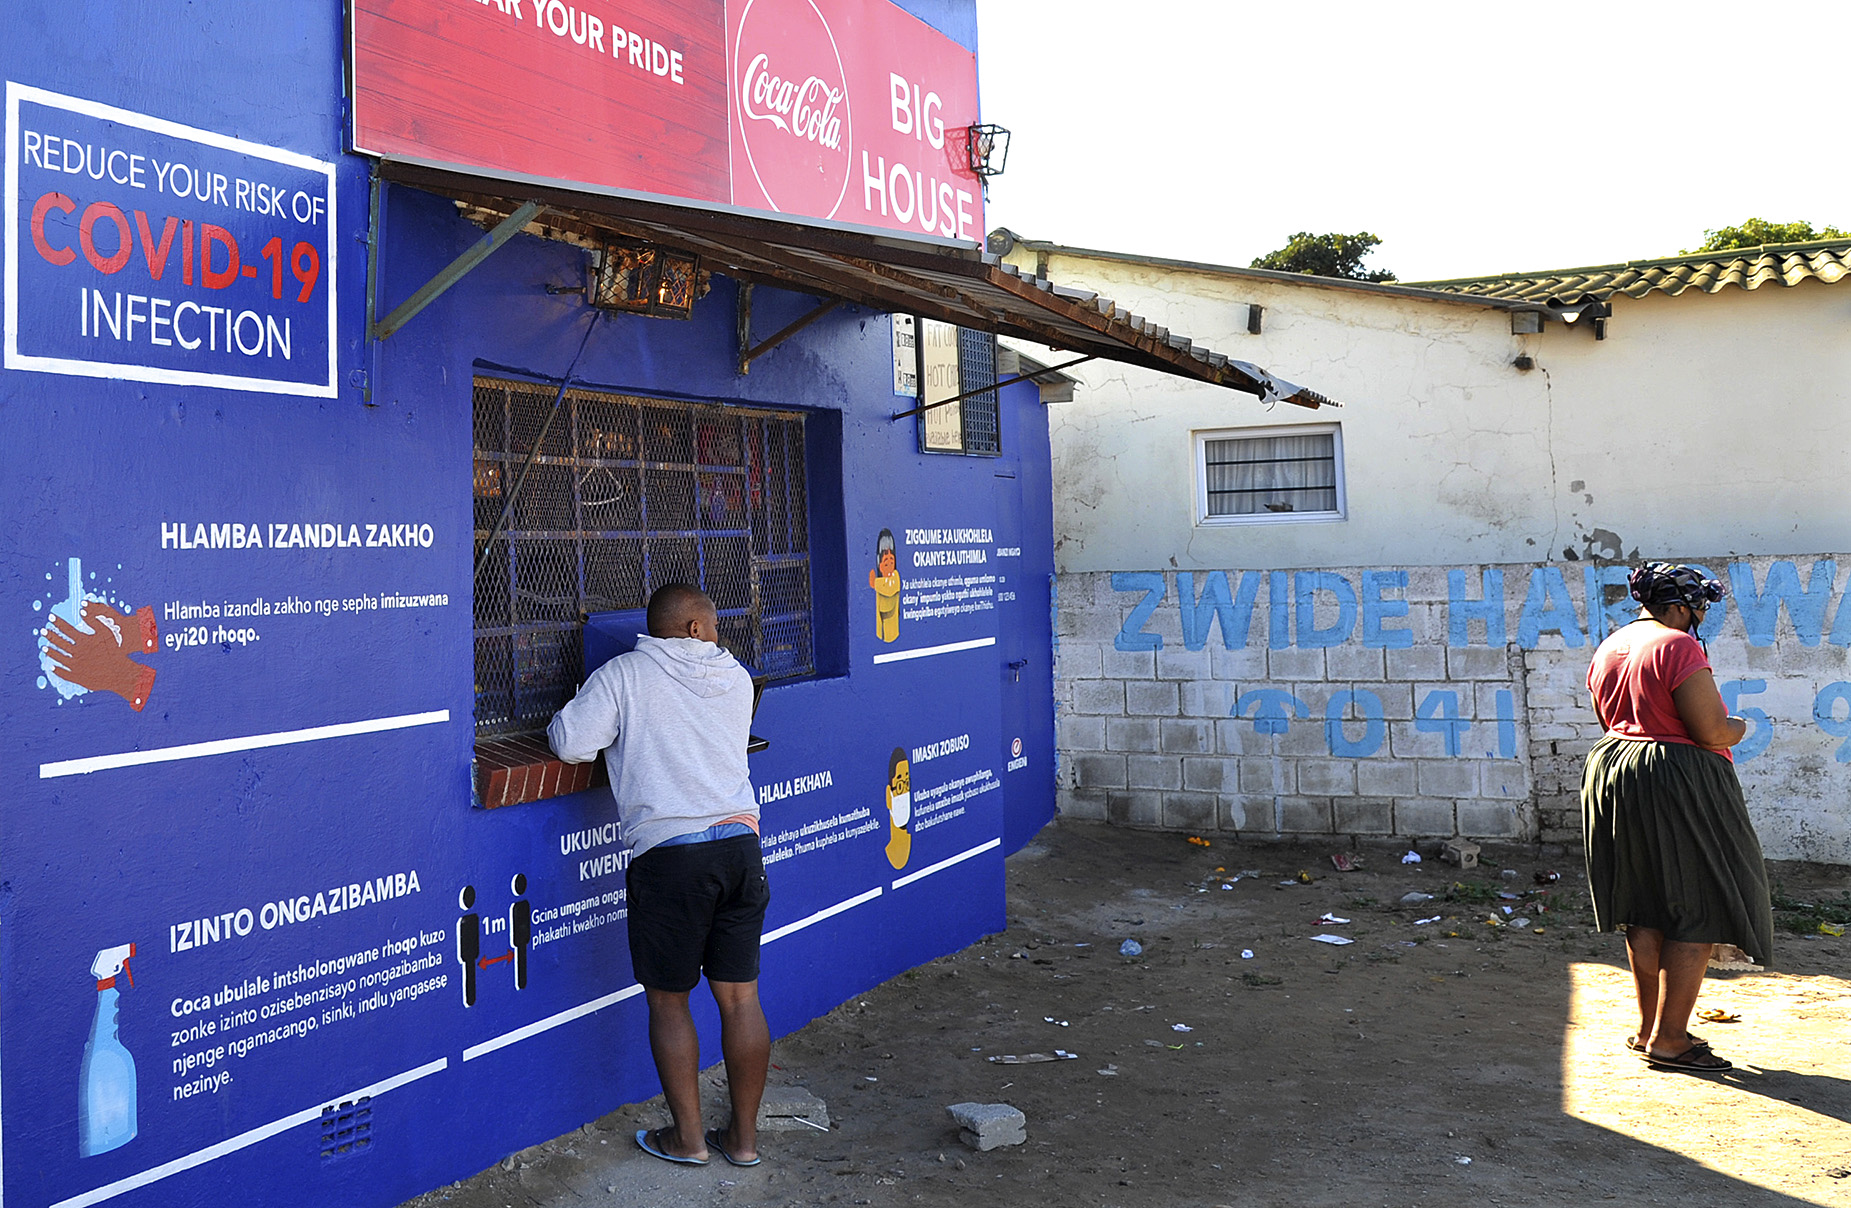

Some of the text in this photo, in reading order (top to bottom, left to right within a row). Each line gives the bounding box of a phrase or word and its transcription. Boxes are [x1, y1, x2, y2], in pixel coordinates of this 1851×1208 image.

[532, 0, 684, 85] YOUR PRIDE
[742, 53, 845, 151] Coca-Cola
[889, 71, 946, 150] BIG
[23, 130, 325, 225] REDUCE YOUR RISK OF
[861, 150, 975, 241] HOUSE
[30, 191, 320, 303] COVID-19
[81, 287, 291, 360] INFECTION
[926, 364, 945, 388] HOT
[160, 522, 435, 550] HLAMBA IZANDLA ZAKHO
[905, 528, 942, 545] ZIGQUME
[942, 529, 953, 544] XA
[913, 550, 945, 567] OKANYE
[946, 550, 957, 565] XA
[163, 592, 449, 621] Hlamba izandla zakho nge sepha imizuzwana
[1110, 570, 1414, 652] ZWIDE
[165, 625, 260, 651] eyi20 rhoqo.
[1324, 688, 1516, 758] 041
[912, 733, 970, 764] IMASKI ZOBUSO
[1007, 756, 1028, 772] ENGEN
[759, 770, 833, 805] HLALA EKHAYA
[560, 821, 622, 856] UKUNCIT
[761, 833, 777, 849] Hlala
[777, 829, 800, 842] ekhaya
[794, 840, 815, 856] Phuma
[170, 870, 421, 953] IZINTO ONGAZIBAMBA
[482, 916, 506, 936] 1m
[531, 907, 558, 925] Gcina
[560, 895, 600, 917] umgama
[532, 921, 571, 950] phakathi
[573, 912, 605, 934] kwakho
[171, 928, 446, 1018] Coca ubulale intsholongwane rhoqo kuzo
[171, 952, 442, 1047] zonke izinto ozisebenzisayo nongazibamba
[172, 973, 448, 1077] njenge ngamacango, isinki, indlu yangasese
[173, 1069, 234, 1101] nezinye.
